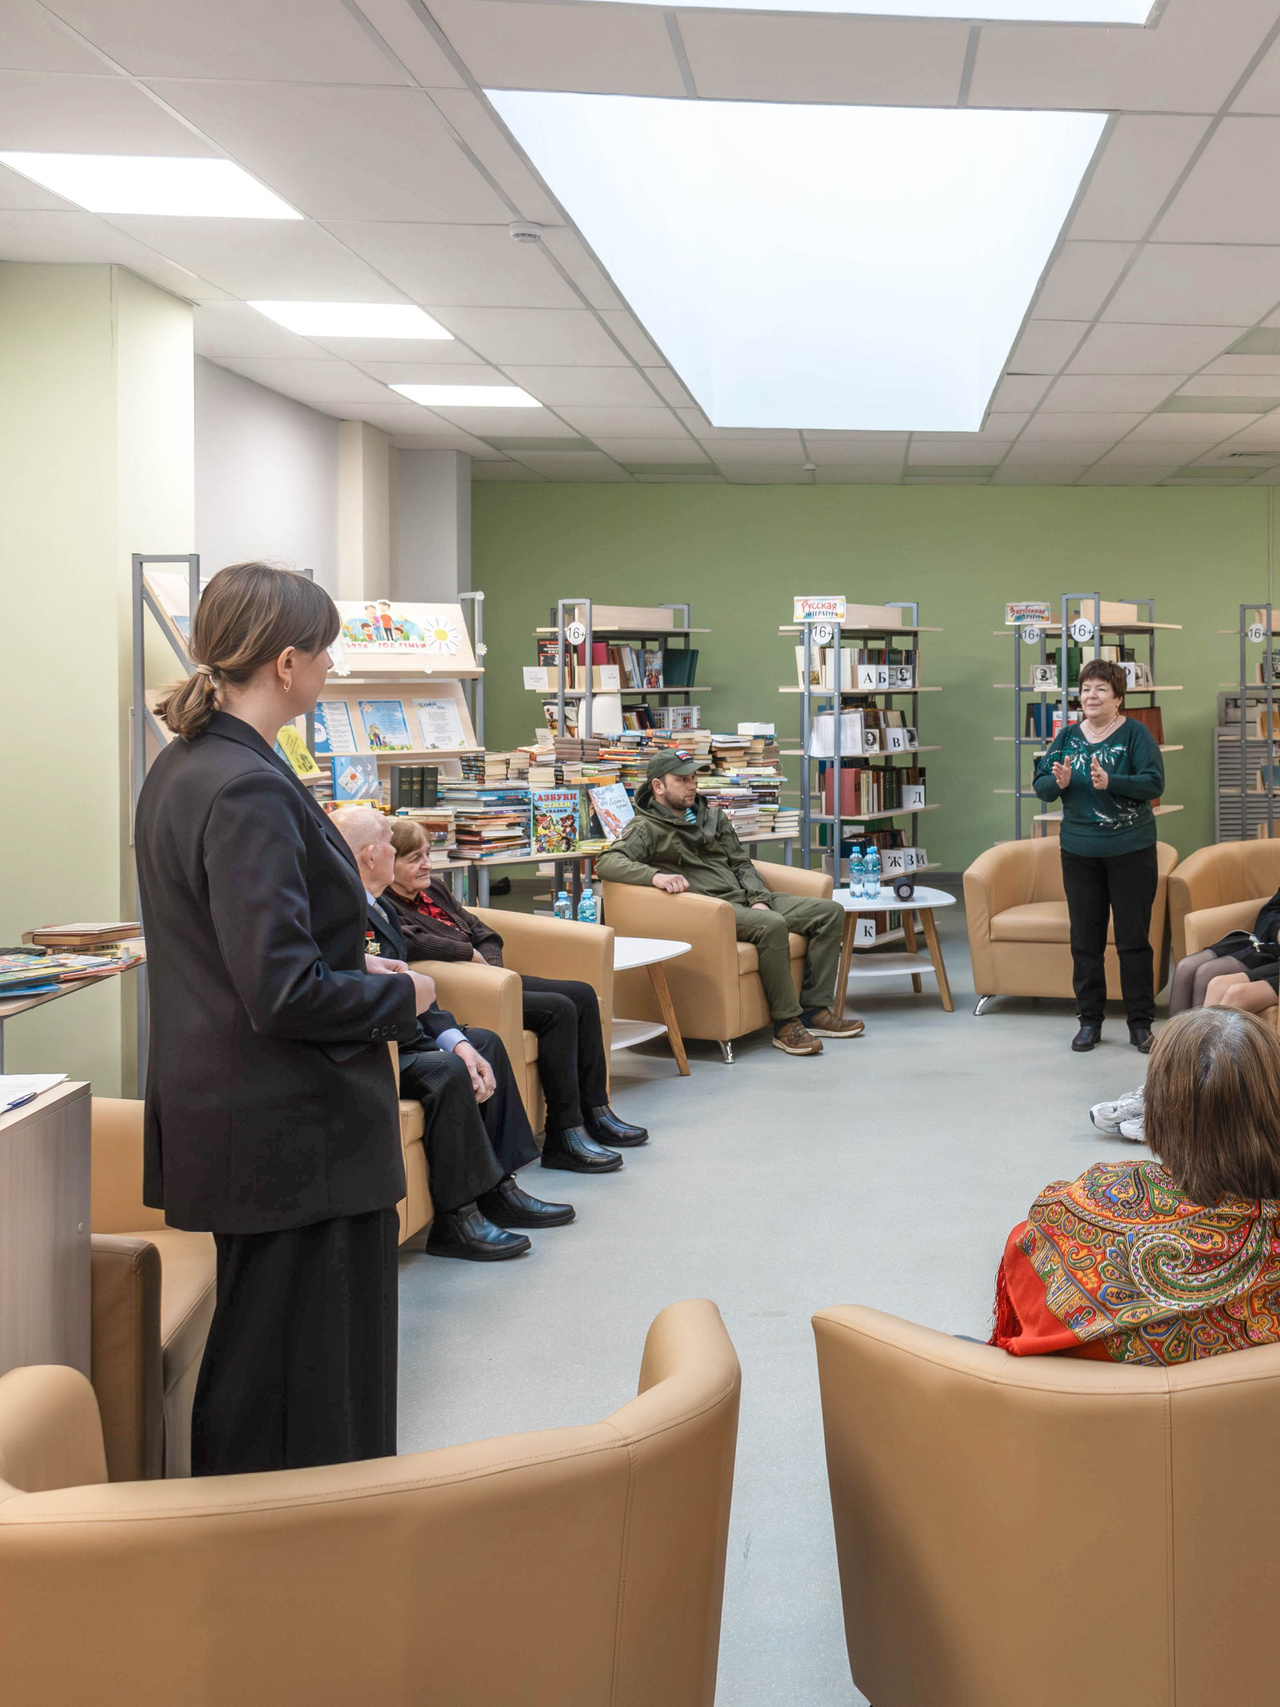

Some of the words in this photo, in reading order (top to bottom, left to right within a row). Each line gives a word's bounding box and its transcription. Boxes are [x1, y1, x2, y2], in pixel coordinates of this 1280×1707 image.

[801, 600, 837, 613] Русская
[567, 626, 585, 640] 16+
[812, 625, 834, 638] 16+
[1023, 629, 1041, 640] 16+
[1072, 624, 1094, 637] 16+
[1248, 628, 1267, 639] 16+
[863, 671, 874, 684] А
[877, 671, 887, 684] Б
[892, 737, 901, 748] В
[536, 793, 577, 802] АЗБУКИ
[912, 791, 923, 804] Д
[887, 856, 903, 868] Ж
[906, 854, 915, 866] З
[916, 853, 926, 865] И
[863, 925, 874, 938] К
